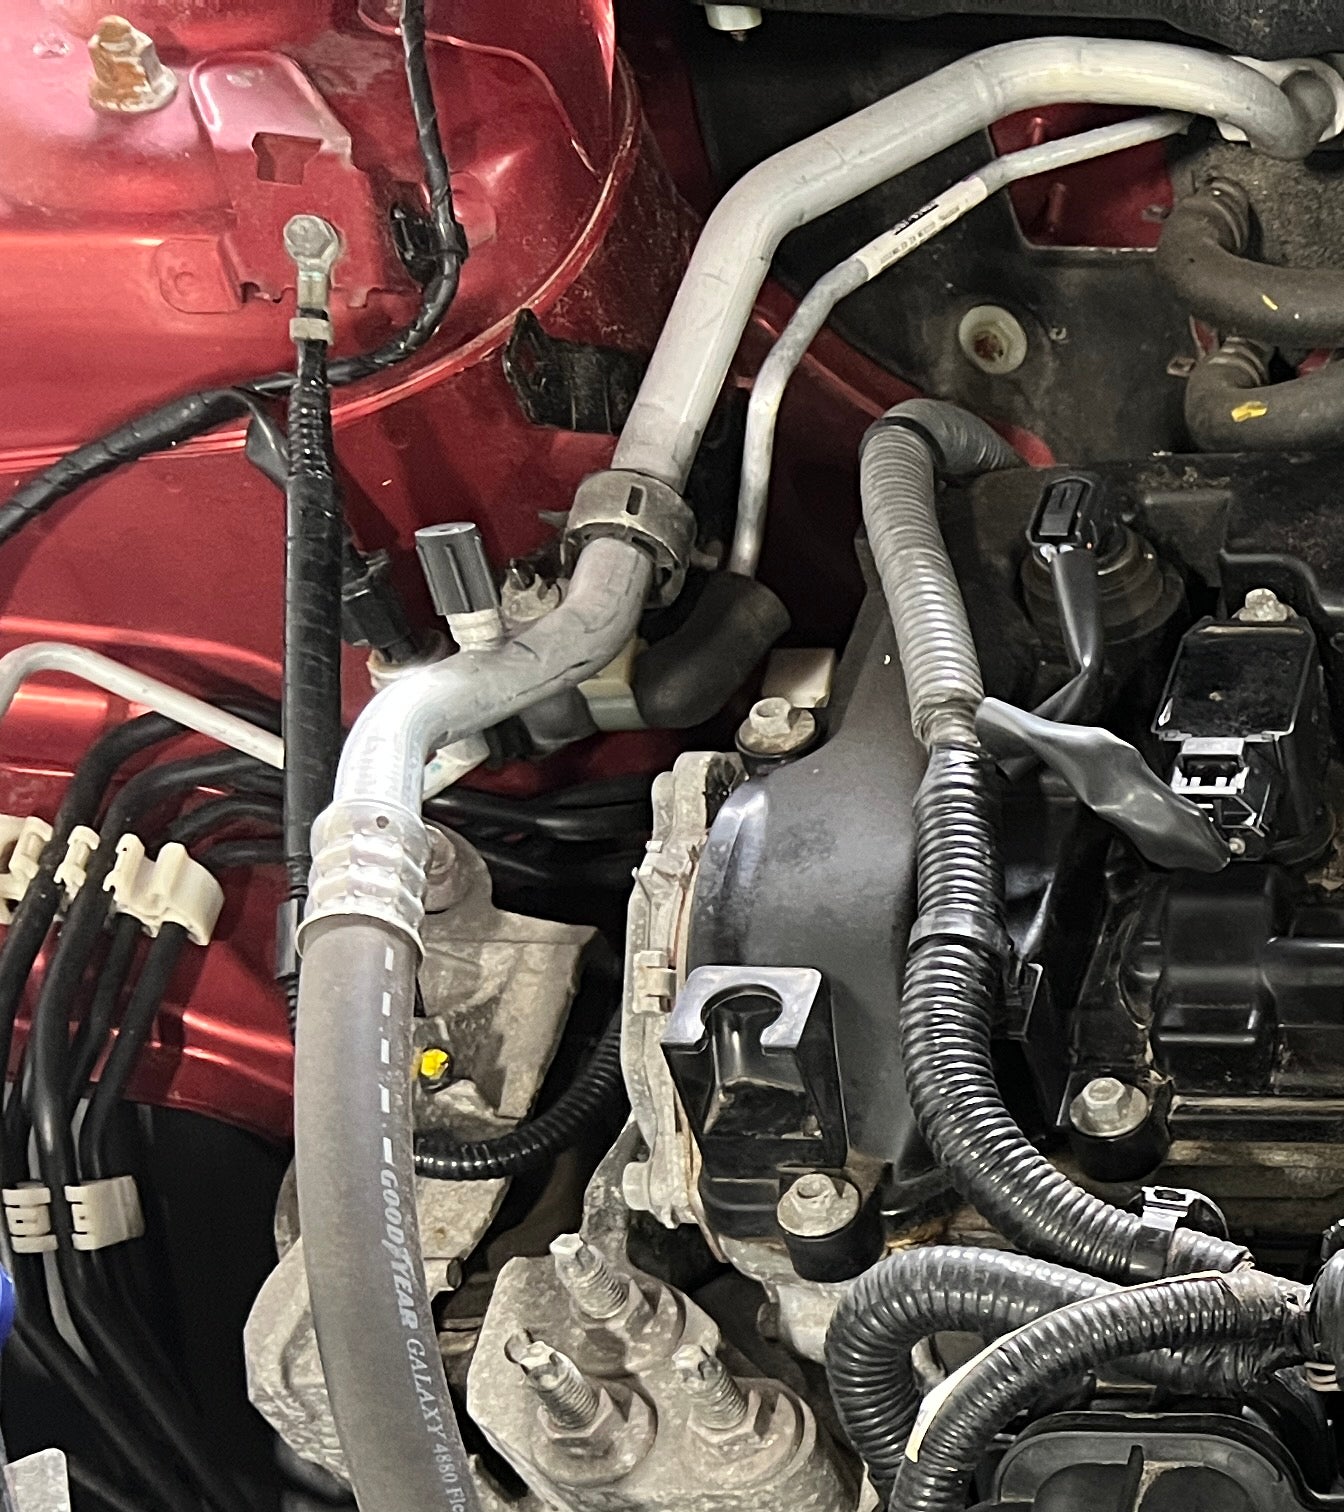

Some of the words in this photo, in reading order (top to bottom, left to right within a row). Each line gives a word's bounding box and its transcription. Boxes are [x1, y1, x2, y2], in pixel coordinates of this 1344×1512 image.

[381, 1169, 420, 1330] GOODYEAR
[406, 1338, 447, 1440] GALAXY
[433, 1443, 458, 1483] 4880
